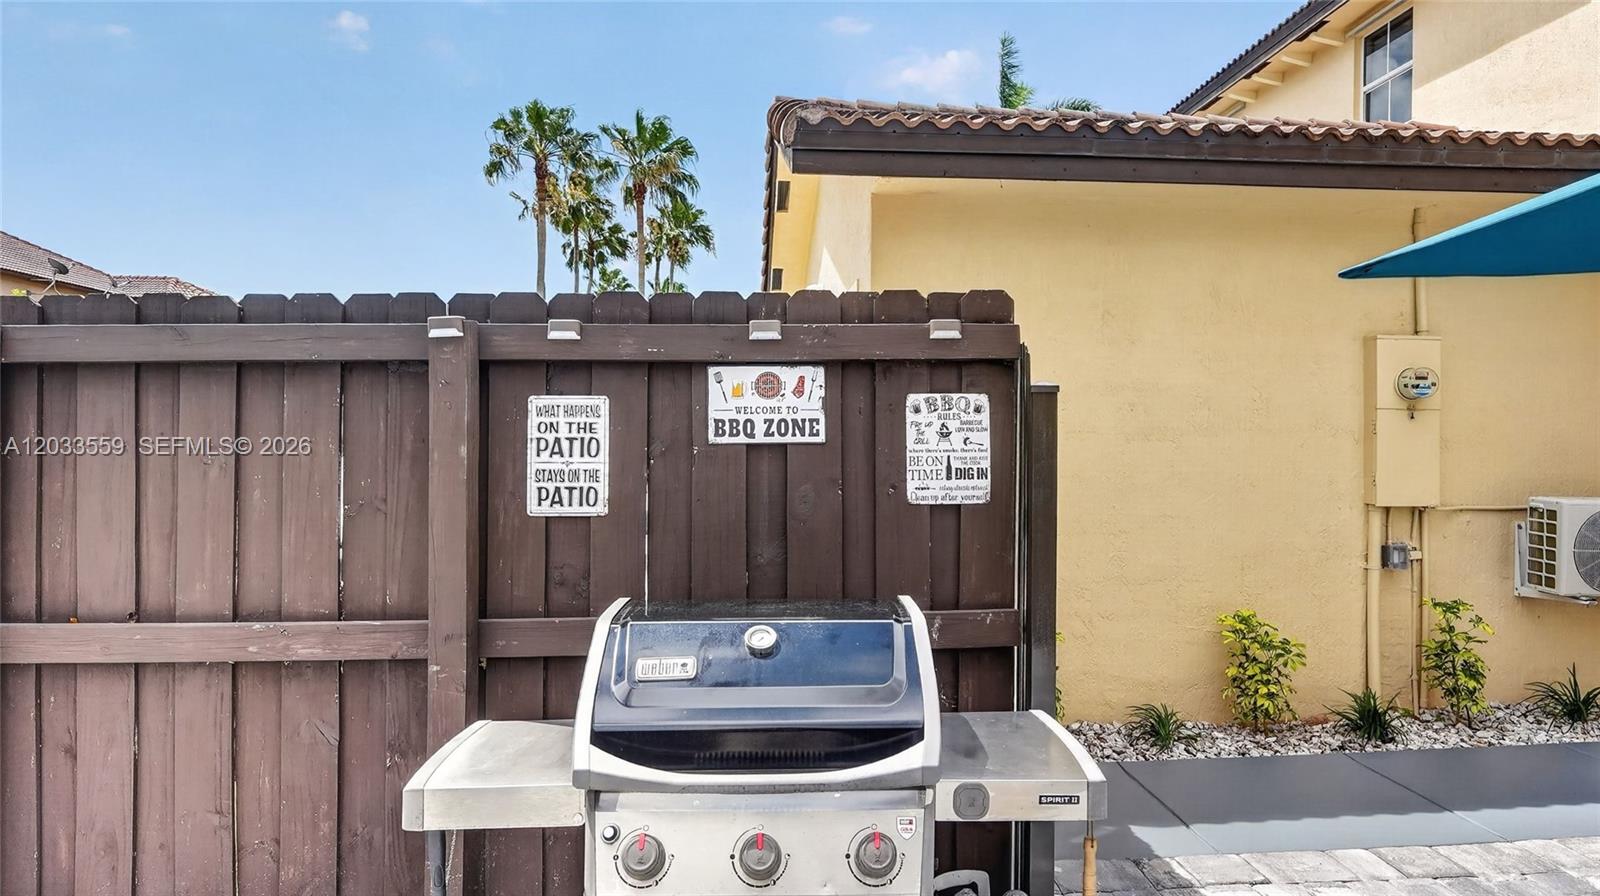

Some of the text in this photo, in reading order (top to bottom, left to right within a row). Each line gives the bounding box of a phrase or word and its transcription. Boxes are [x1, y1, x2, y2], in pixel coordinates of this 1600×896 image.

[535, 404, 601, 418] WHAT HAPPENS
[735, 406, 799, 415] WELCOME TO
[923, 395, 971, 415] BBQ
[937, 412, 961, 420] RULES
[537, 421, 599, 434] ON THE
[713, 418, 820, 439] BBQ ZONE
[535, 437, 600, 458] PATIO
[908, 455, 943, 467] BE ON
[535, 469, 600, 483] STAYS ON THE
[908, 469, 944, 480] TIME
[955, 467, 988, 480] DIG IN
[536, 486, 598, 507] PATIO
